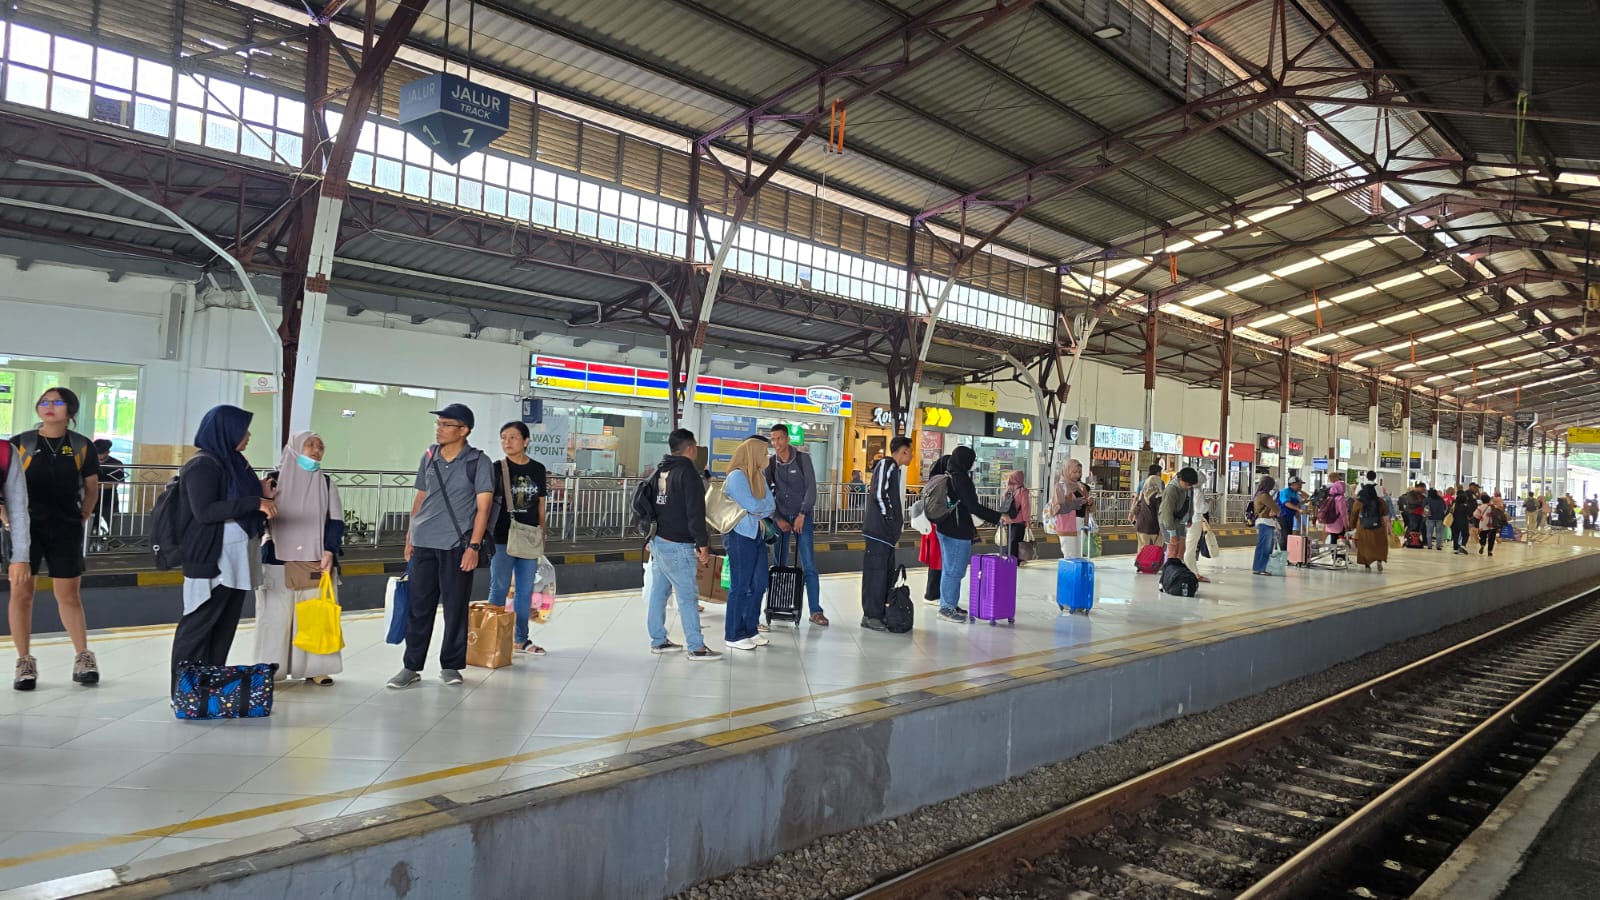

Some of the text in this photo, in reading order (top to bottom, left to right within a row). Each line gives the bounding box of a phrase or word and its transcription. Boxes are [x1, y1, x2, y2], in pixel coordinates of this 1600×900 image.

[406, 82, 435, 104] JALUR
[451, 84, 501, 111] JALUR
[460, 103, 491, 120] TRACK
[422, 125, 441, 145] 1
[457, 128, 475, 148] 1
[534, 446, 565, 456] POINT
[1093, 448, 1136, 462] GRAND CAFE
